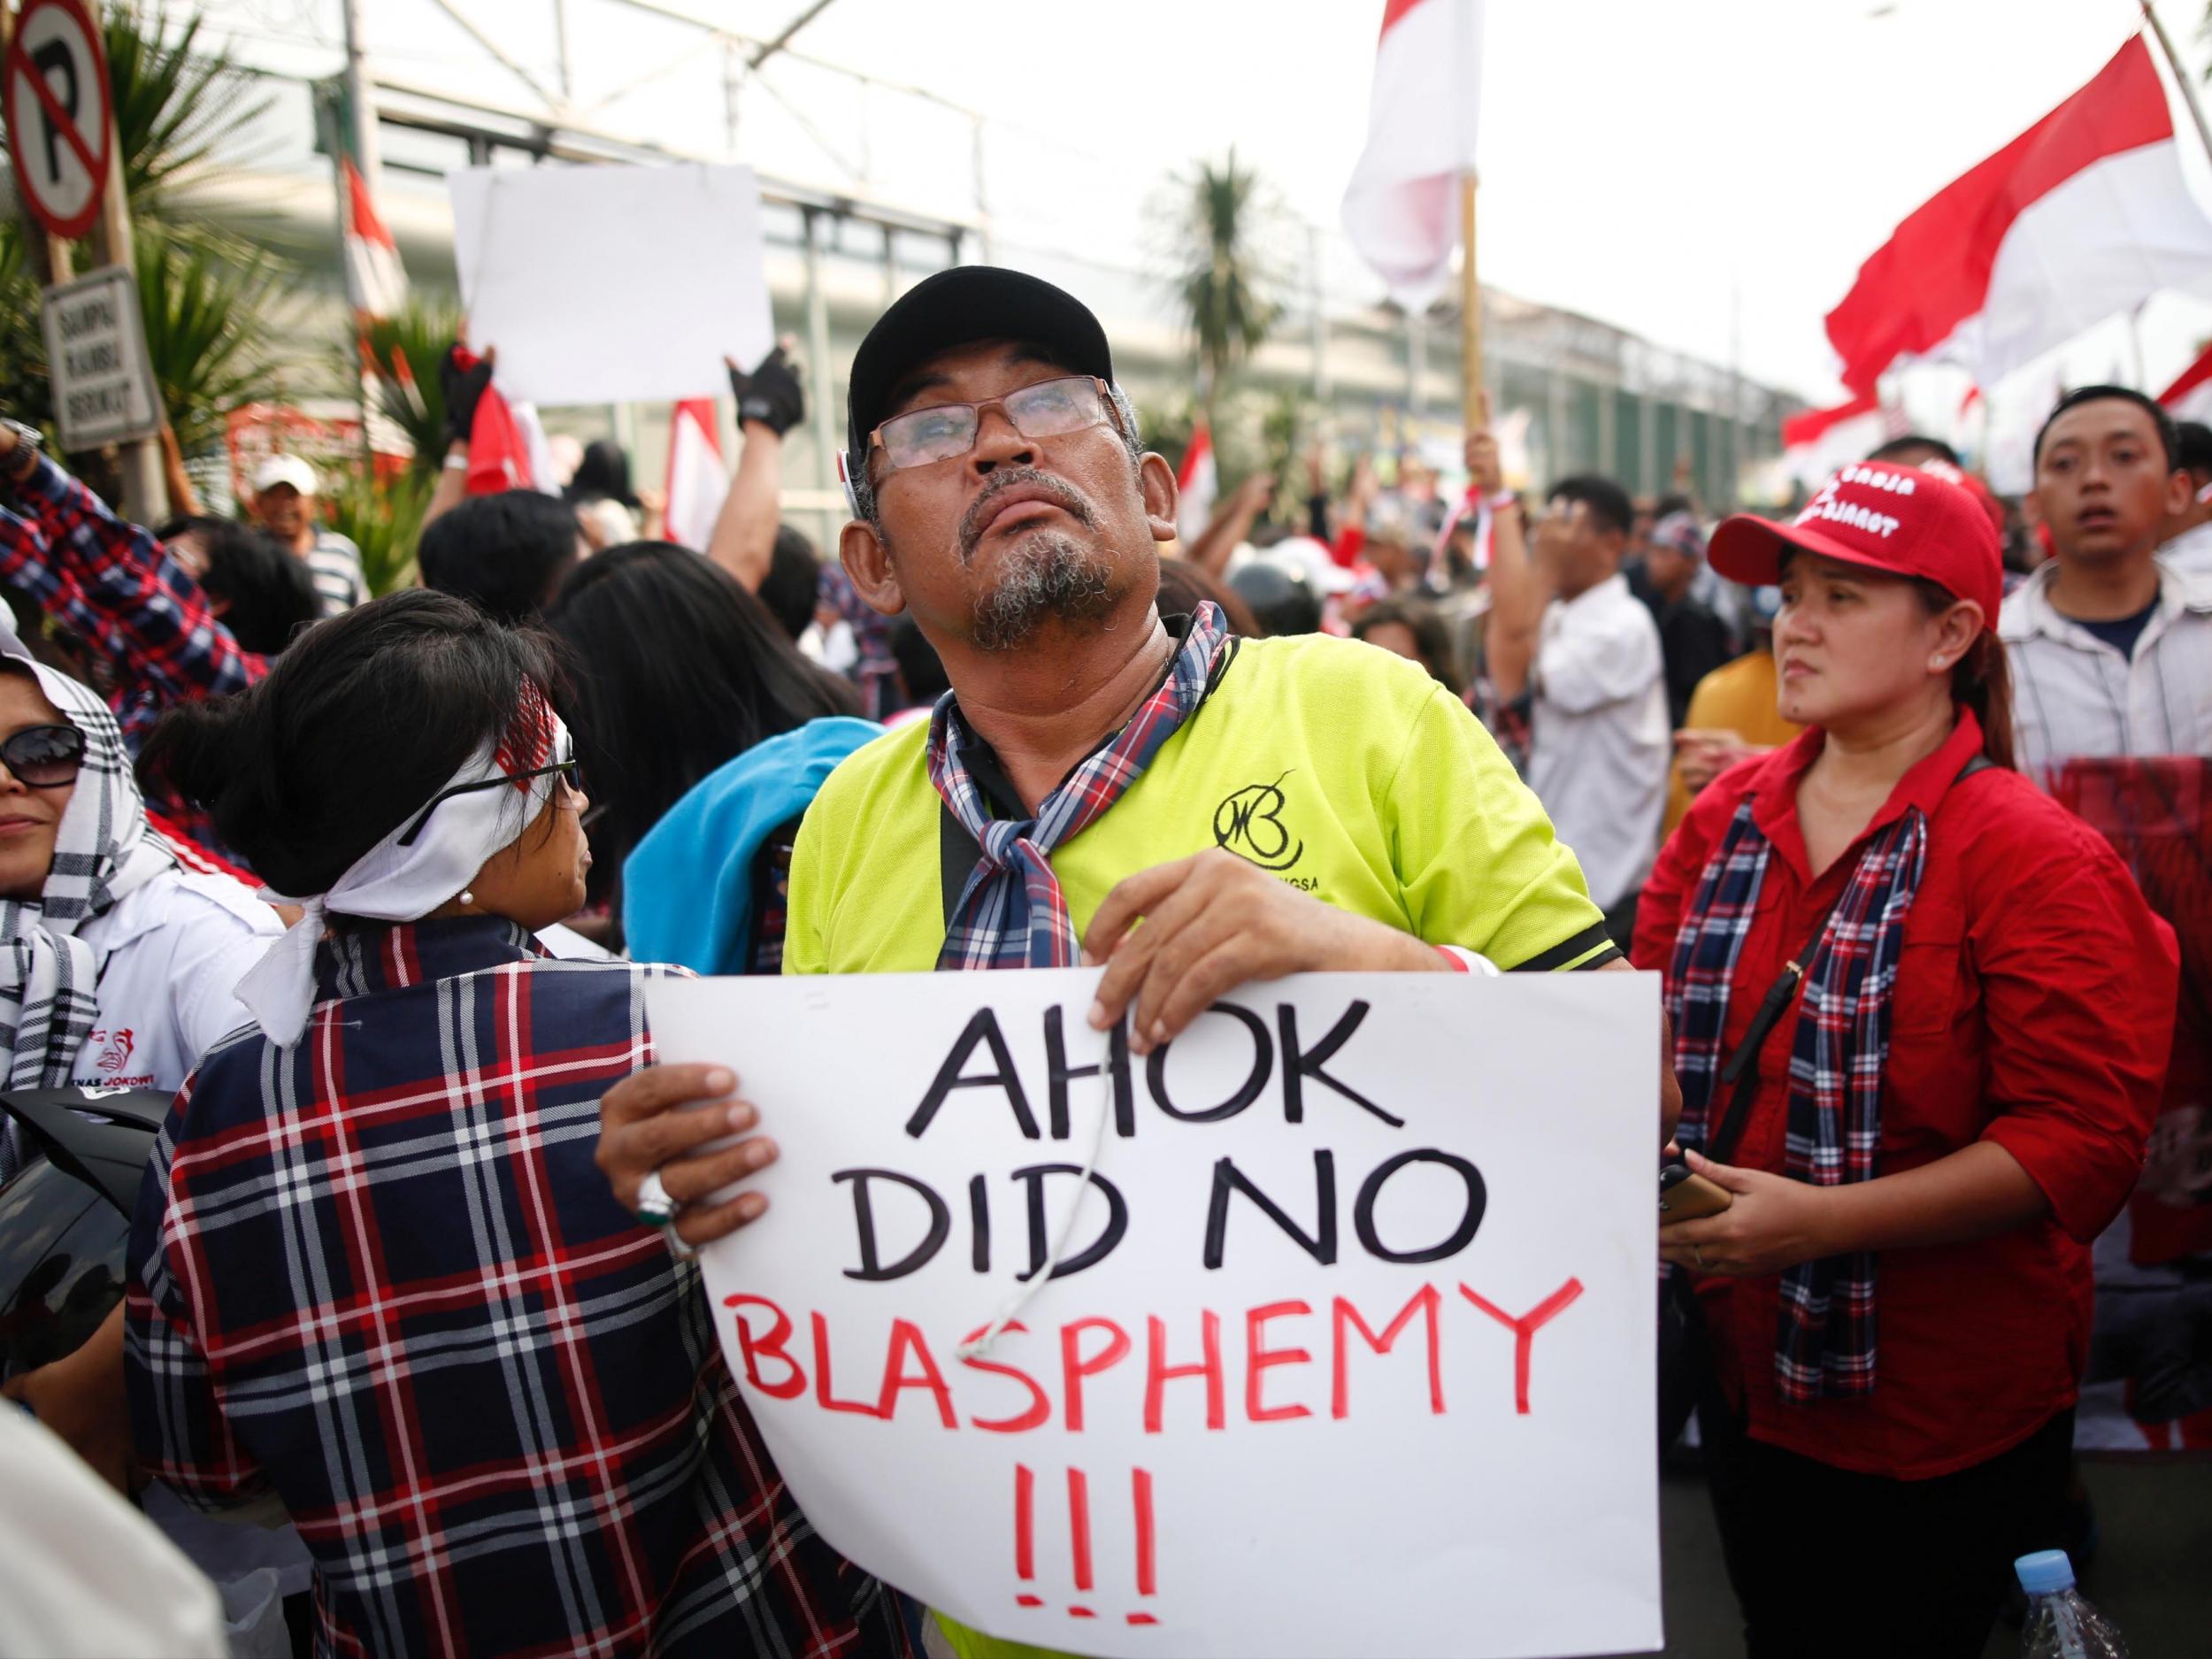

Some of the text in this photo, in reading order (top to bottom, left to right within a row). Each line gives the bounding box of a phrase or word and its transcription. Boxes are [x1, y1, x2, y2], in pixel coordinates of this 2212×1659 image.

[33, 35, 78, 186] P
[905, 999, 1405, 1140] AHOK
[832, 1148, 1487, 1282] DID NO
[722, 1277, 1586, 1434] BLASPHEMY
[1015, 1463, 1159, 1625] !!!
